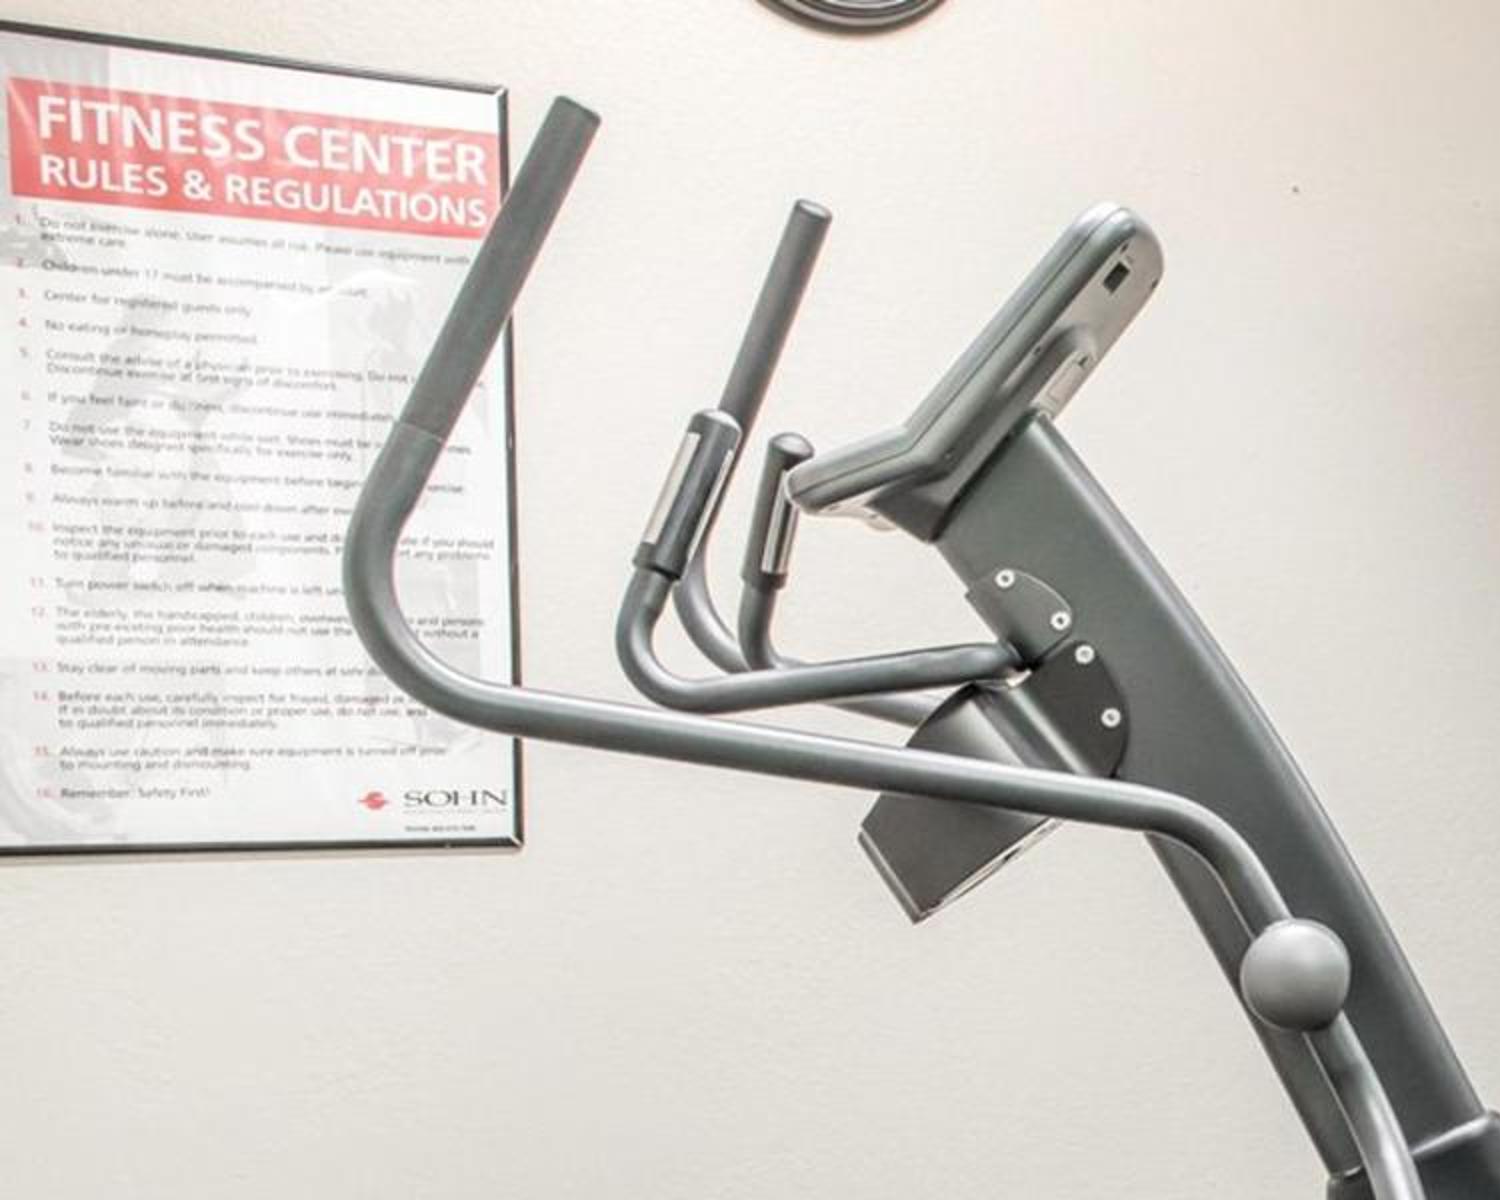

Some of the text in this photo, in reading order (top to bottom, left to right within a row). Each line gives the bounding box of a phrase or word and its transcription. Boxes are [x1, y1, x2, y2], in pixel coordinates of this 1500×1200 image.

[38, 95, 488, 186] FITNESS CENTER
[39, 154, 488, 229] RULES & REGULATIONS
[403, 789, 507, 807] SOHN
